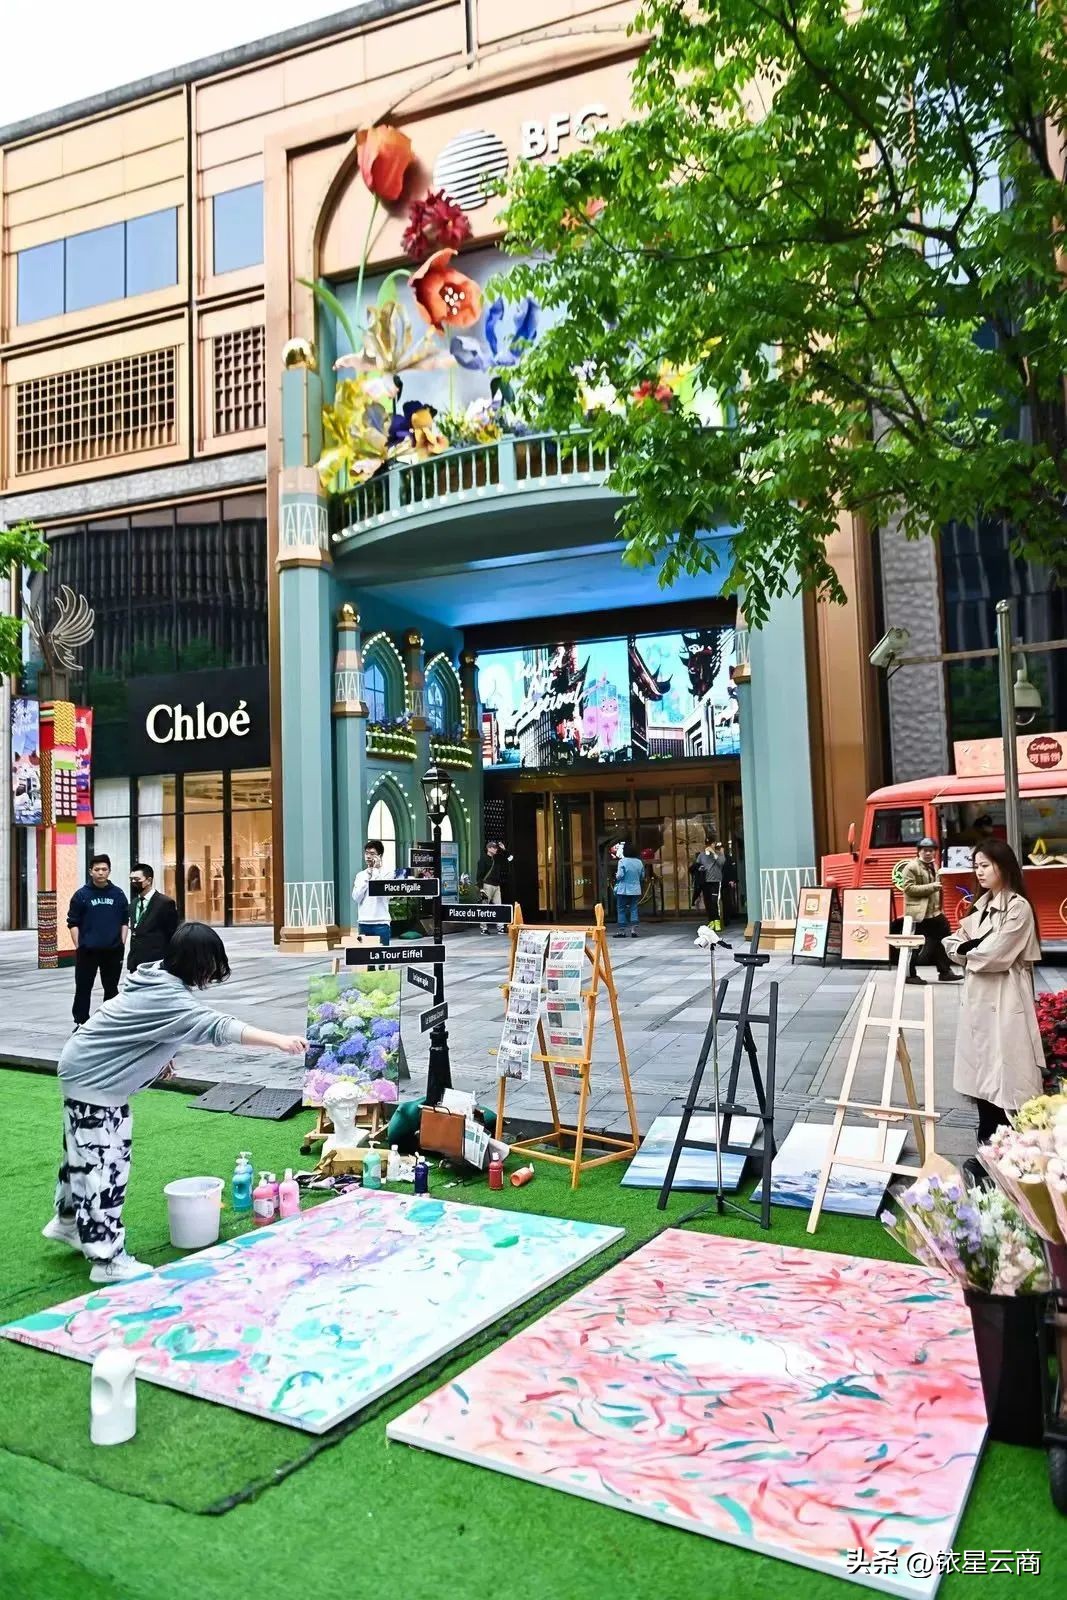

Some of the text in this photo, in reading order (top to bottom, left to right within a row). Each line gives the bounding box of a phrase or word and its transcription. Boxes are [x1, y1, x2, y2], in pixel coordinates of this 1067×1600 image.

[146, 700, 251, 744] Chloé
[384, 882, 421, 893] Place Pigalle
[449, 908, 497, 918] Place du Tertre
[369, 950, 423, 960] La Tour Eiffel
